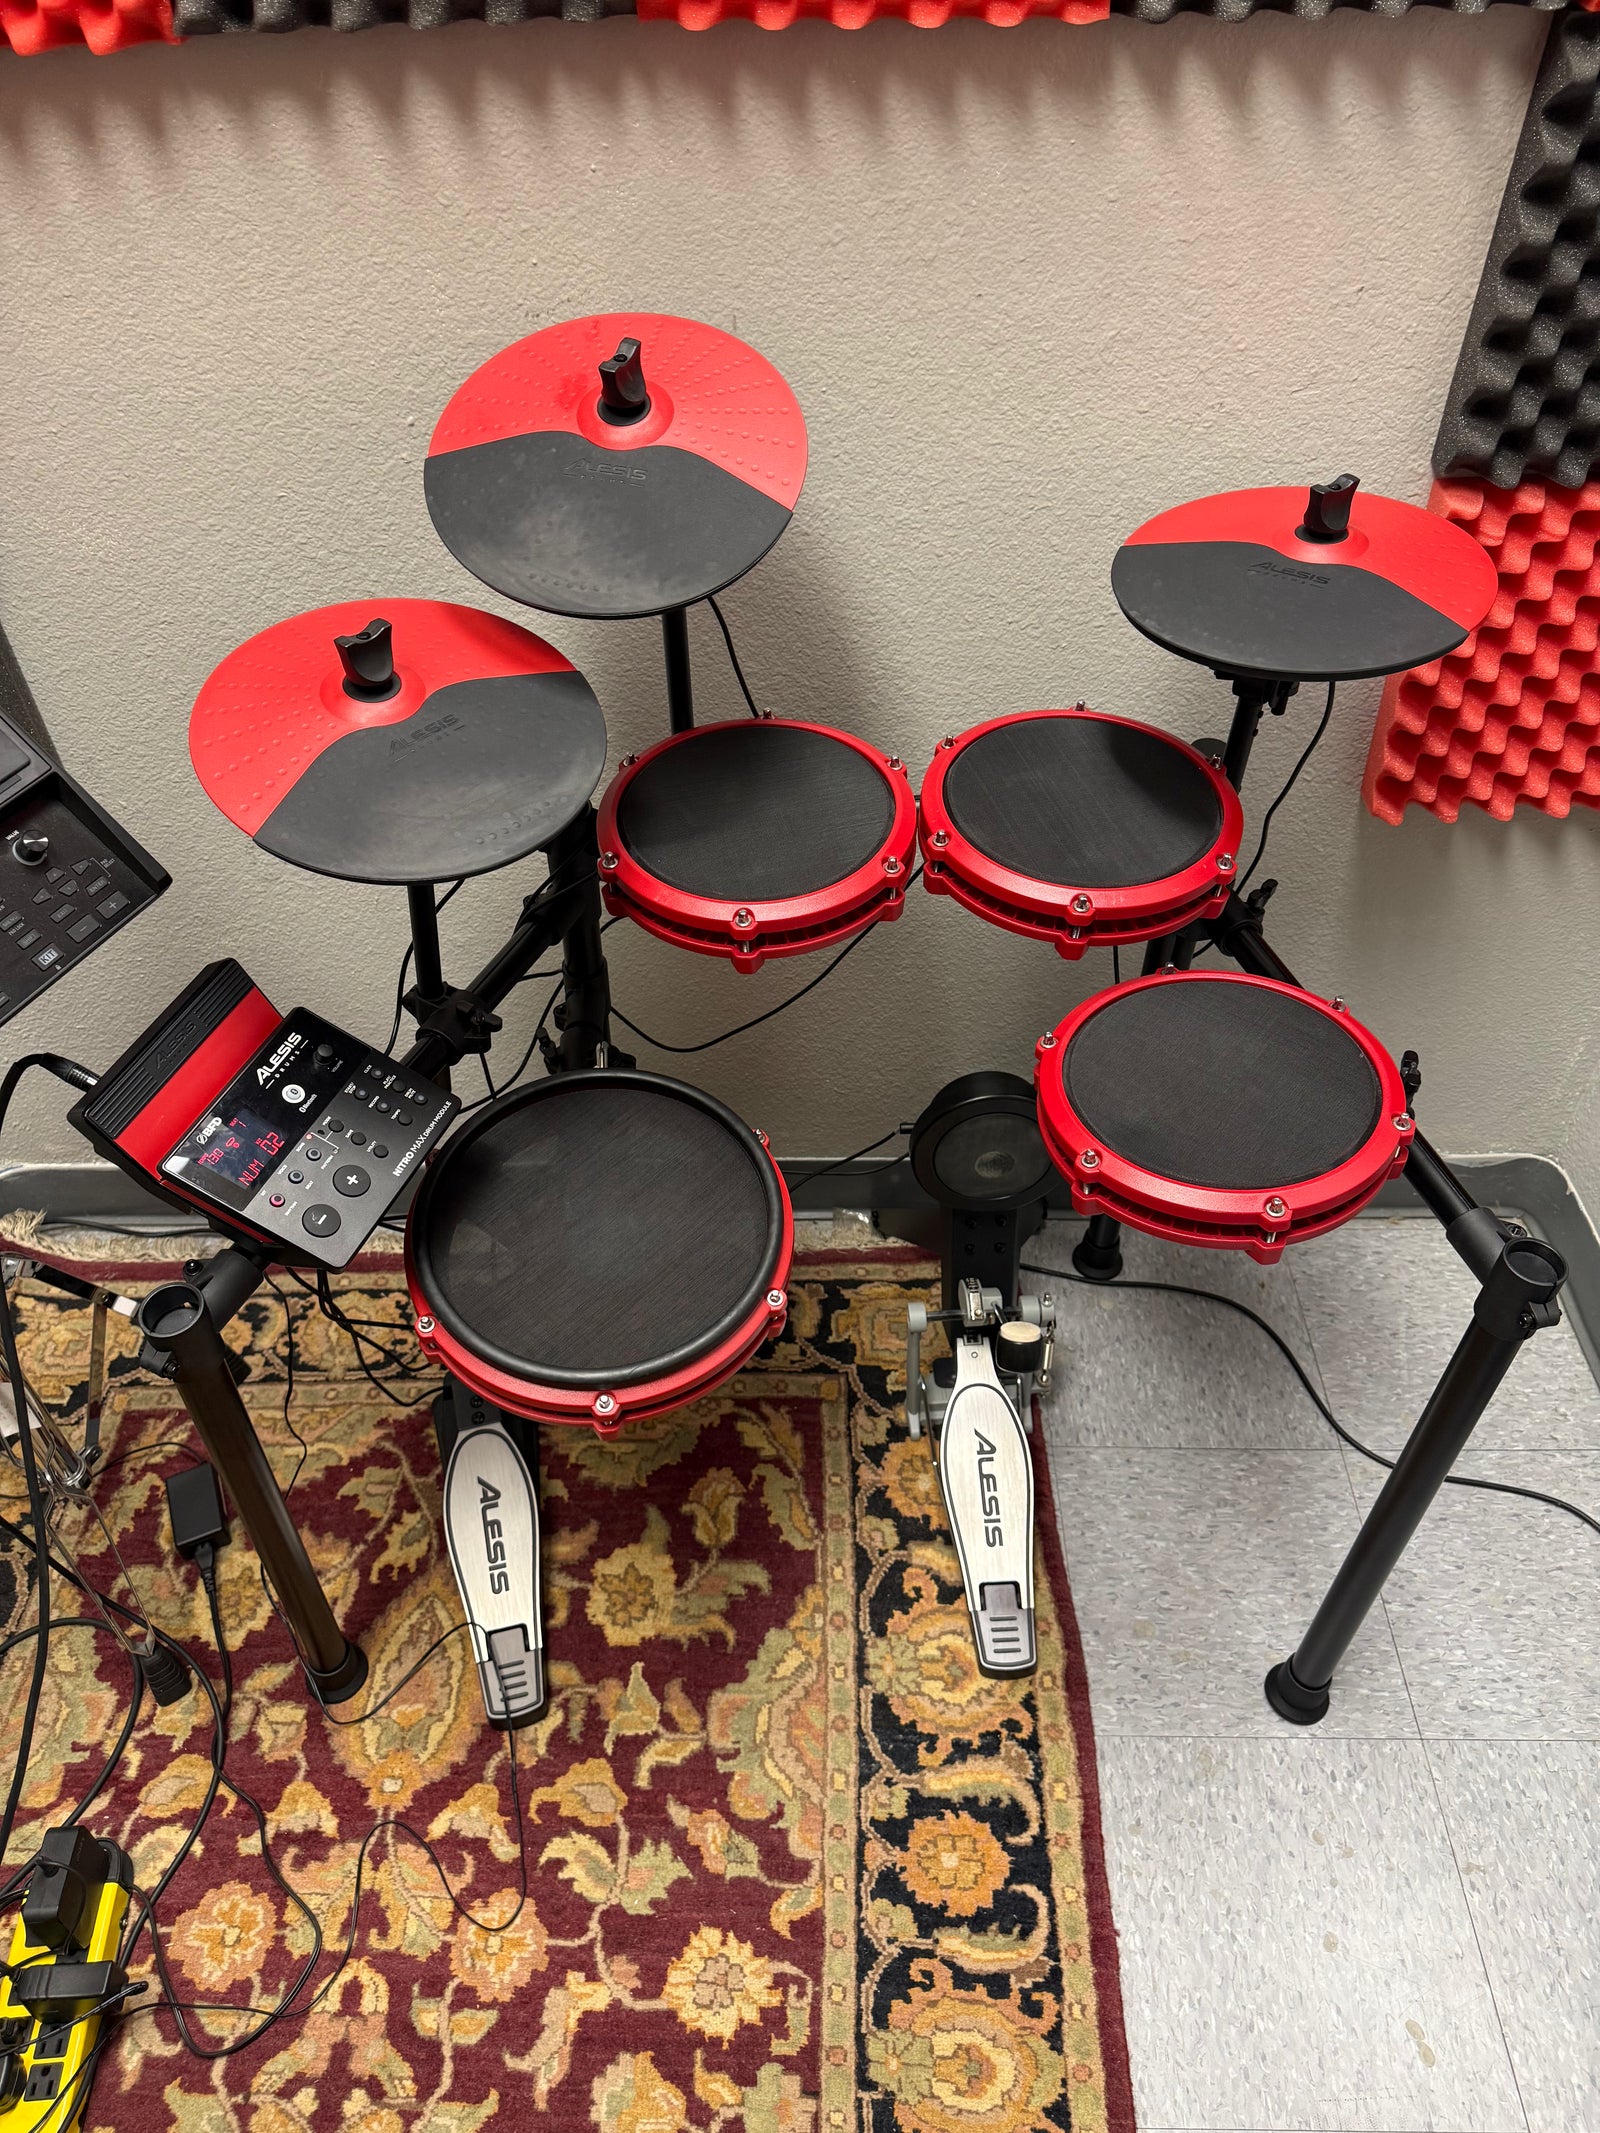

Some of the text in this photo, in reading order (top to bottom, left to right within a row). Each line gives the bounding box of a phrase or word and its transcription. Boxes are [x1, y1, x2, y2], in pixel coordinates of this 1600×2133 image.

[564, 458, 648, 480] ALESIS
[1248, 562, 1331, 584] ALESIS
[389, 713, 460, 757] ALESIS
[6, 830, 19, 840] VALUE
[89, 879, 106, 893] ENTER
[41, 950, 56, 964] KIT
[156, 1021, 197, 1069] ALESIS
[256, 1031, 302, 1086] ALESIS
[274, 1050, 300, 1078] DRUMS
[363, 1064, 373, 1074] CLICK
[384, 1074, 397, 1090] PRACTICE
[368, 1095, 380, 1108] RECORD
[390, 1108, 401, 1120] TEMPO
[203, 1117, 222, 1138] BFD
[345, 1129, 354, 1140] SAVE
[260, 1131, 285, 1156] 02
[366, 1140, 377, 1153] UTILITY
[392, 1100, 452, 1177] NITRO MAX DRUM MODULE
[207, 1147, 224, 1165] 130
[320, 1155, 334, 1170] PATTERN
[238, 1158, 265, 1187] NUM
[277, 1164, 288, 1175] VOICE
[974, 1428, 1003, 1548] ALESIS
[476, 1475, 509, 1595] ALESIS
